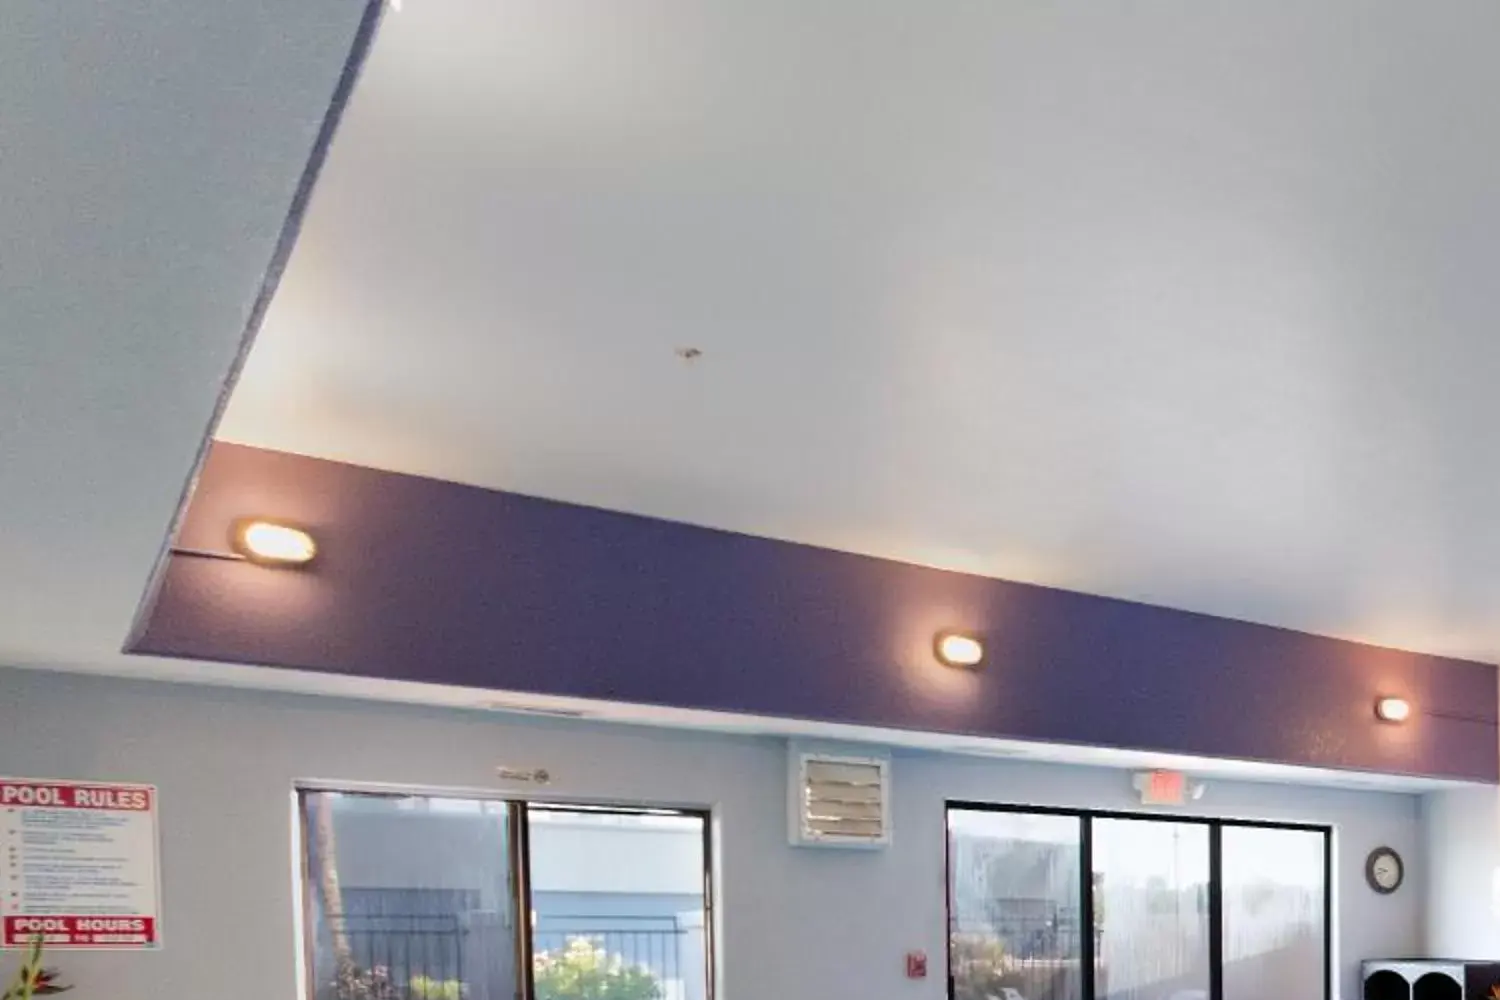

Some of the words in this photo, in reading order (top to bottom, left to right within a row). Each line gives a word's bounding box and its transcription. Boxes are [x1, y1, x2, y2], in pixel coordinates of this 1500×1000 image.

[2, 786, 65, 805] POOL
[74, 790, 146, 809] RULES
[14, 918, 70, 931] POOL
[76, 919, 145, 931] HOURS
